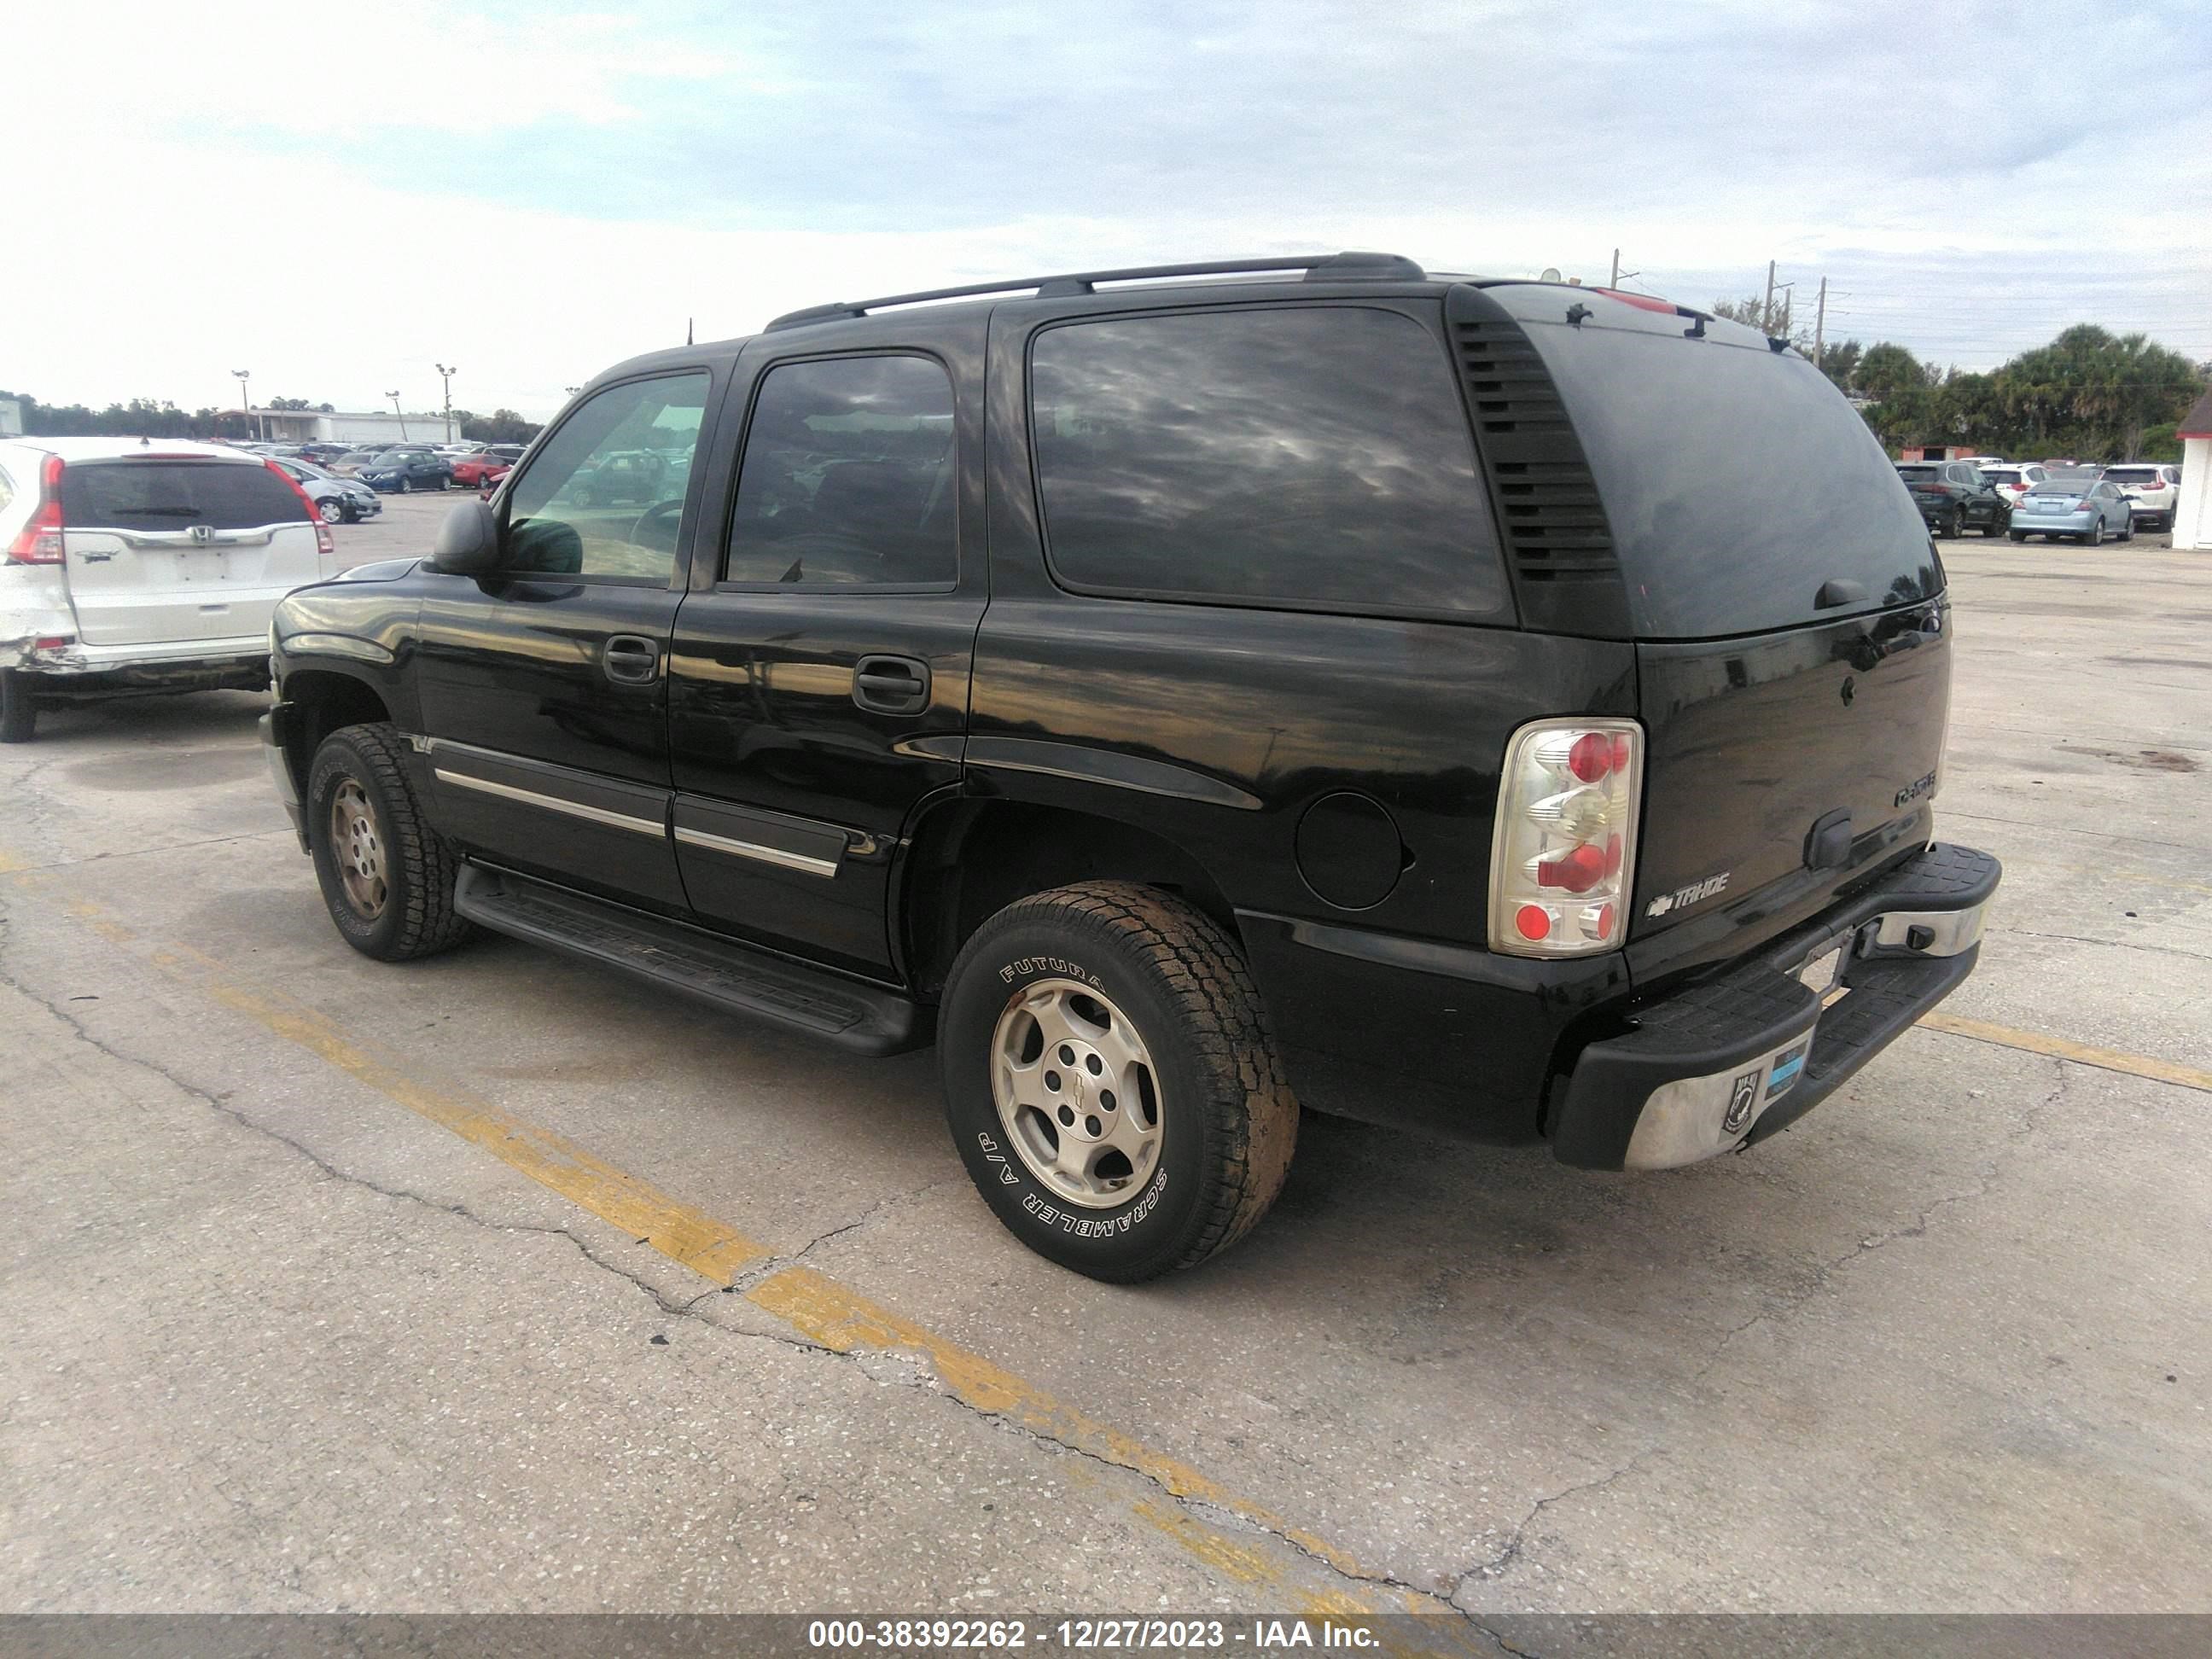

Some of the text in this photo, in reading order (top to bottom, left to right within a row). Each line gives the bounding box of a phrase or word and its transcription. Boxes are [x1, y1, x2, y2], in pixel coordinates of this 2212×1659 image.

[1674, 870, 1731, 911] TAHOE
[998, 957, 1107, 993] FUTURA
[978, 1132, 1168, 1238] SCRAMBLER A/P
